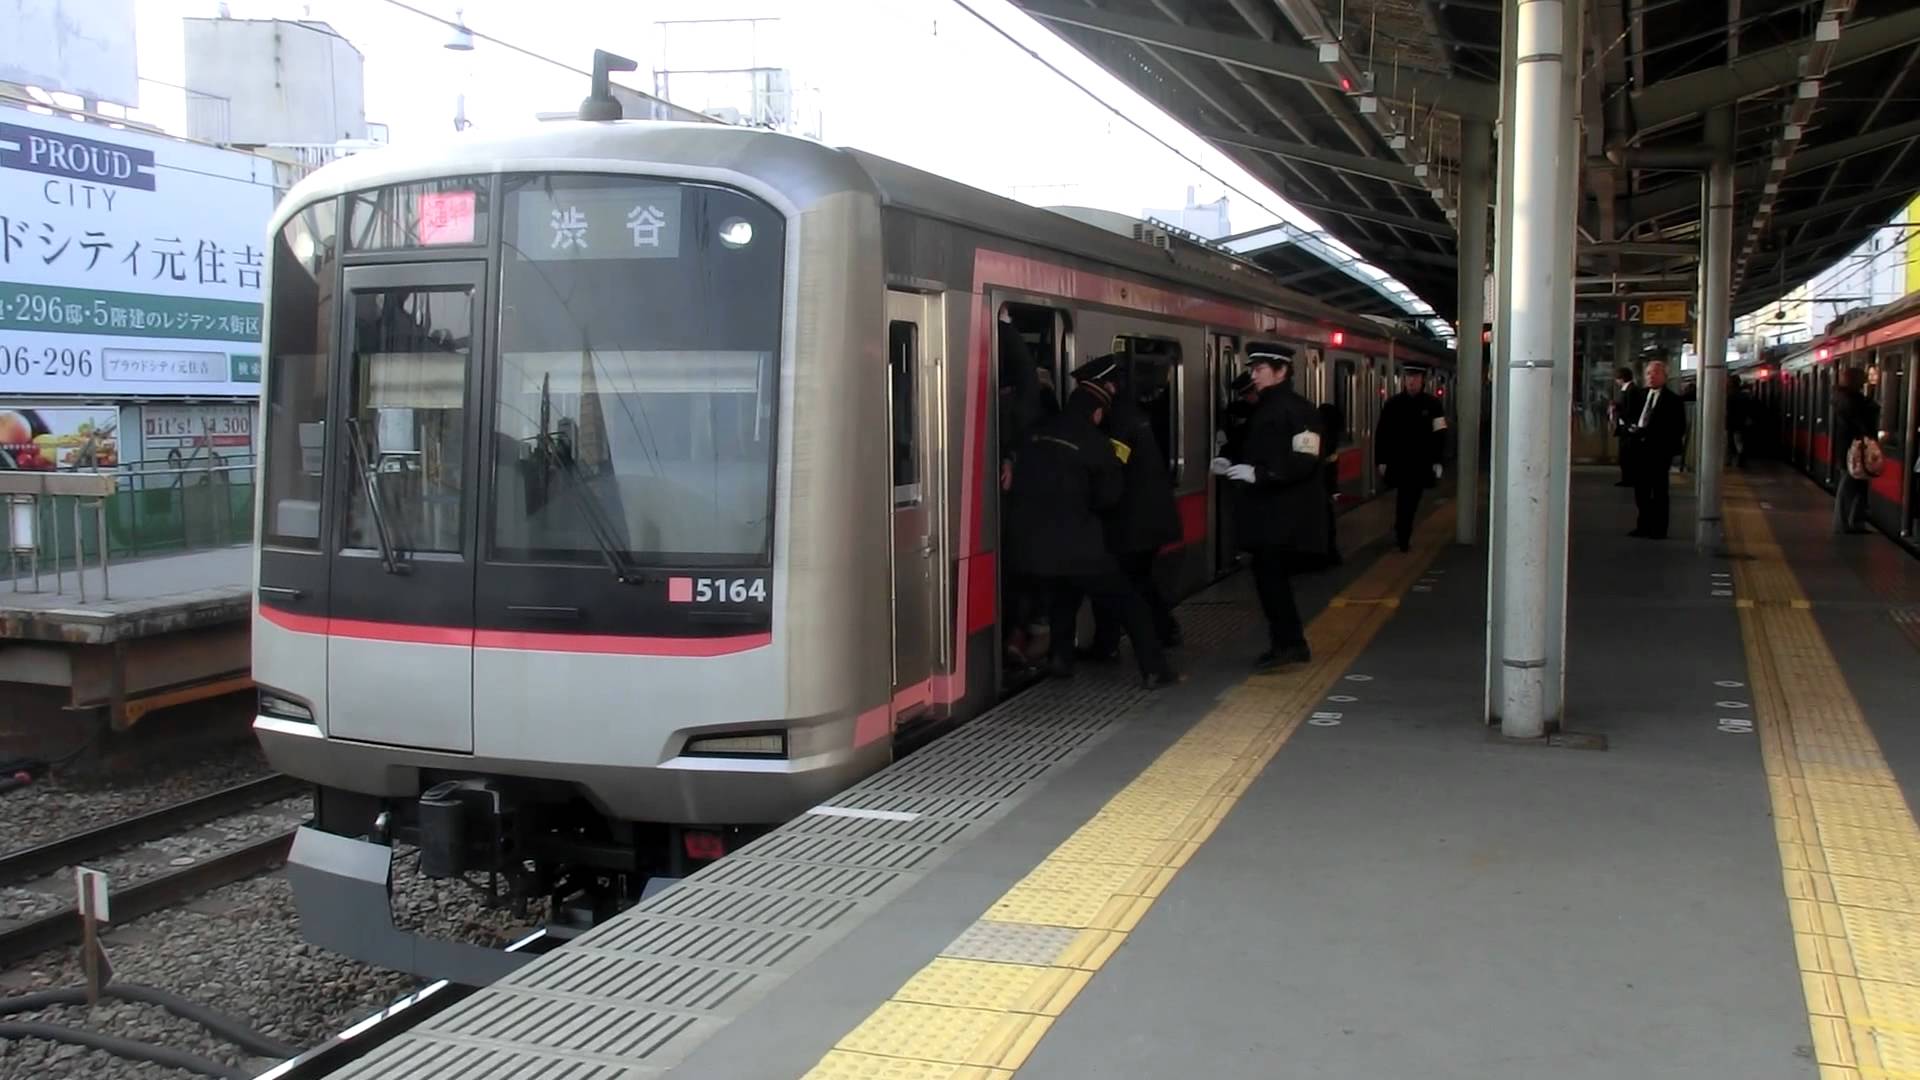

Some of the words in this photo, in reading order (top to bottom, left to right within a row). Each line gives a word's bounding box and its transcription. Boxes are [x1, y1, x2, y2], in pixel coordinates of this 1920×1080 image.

[28, 134, 132, 180] PROUD
[43, 179, 116, 212] CITY
[550, 204, 666, 249] 渋谷
[0, 215, 265, 290] ドシティ元住吉
[1628, 304, 1641, 322] 2
[695, 578, 767, 603] 5164
